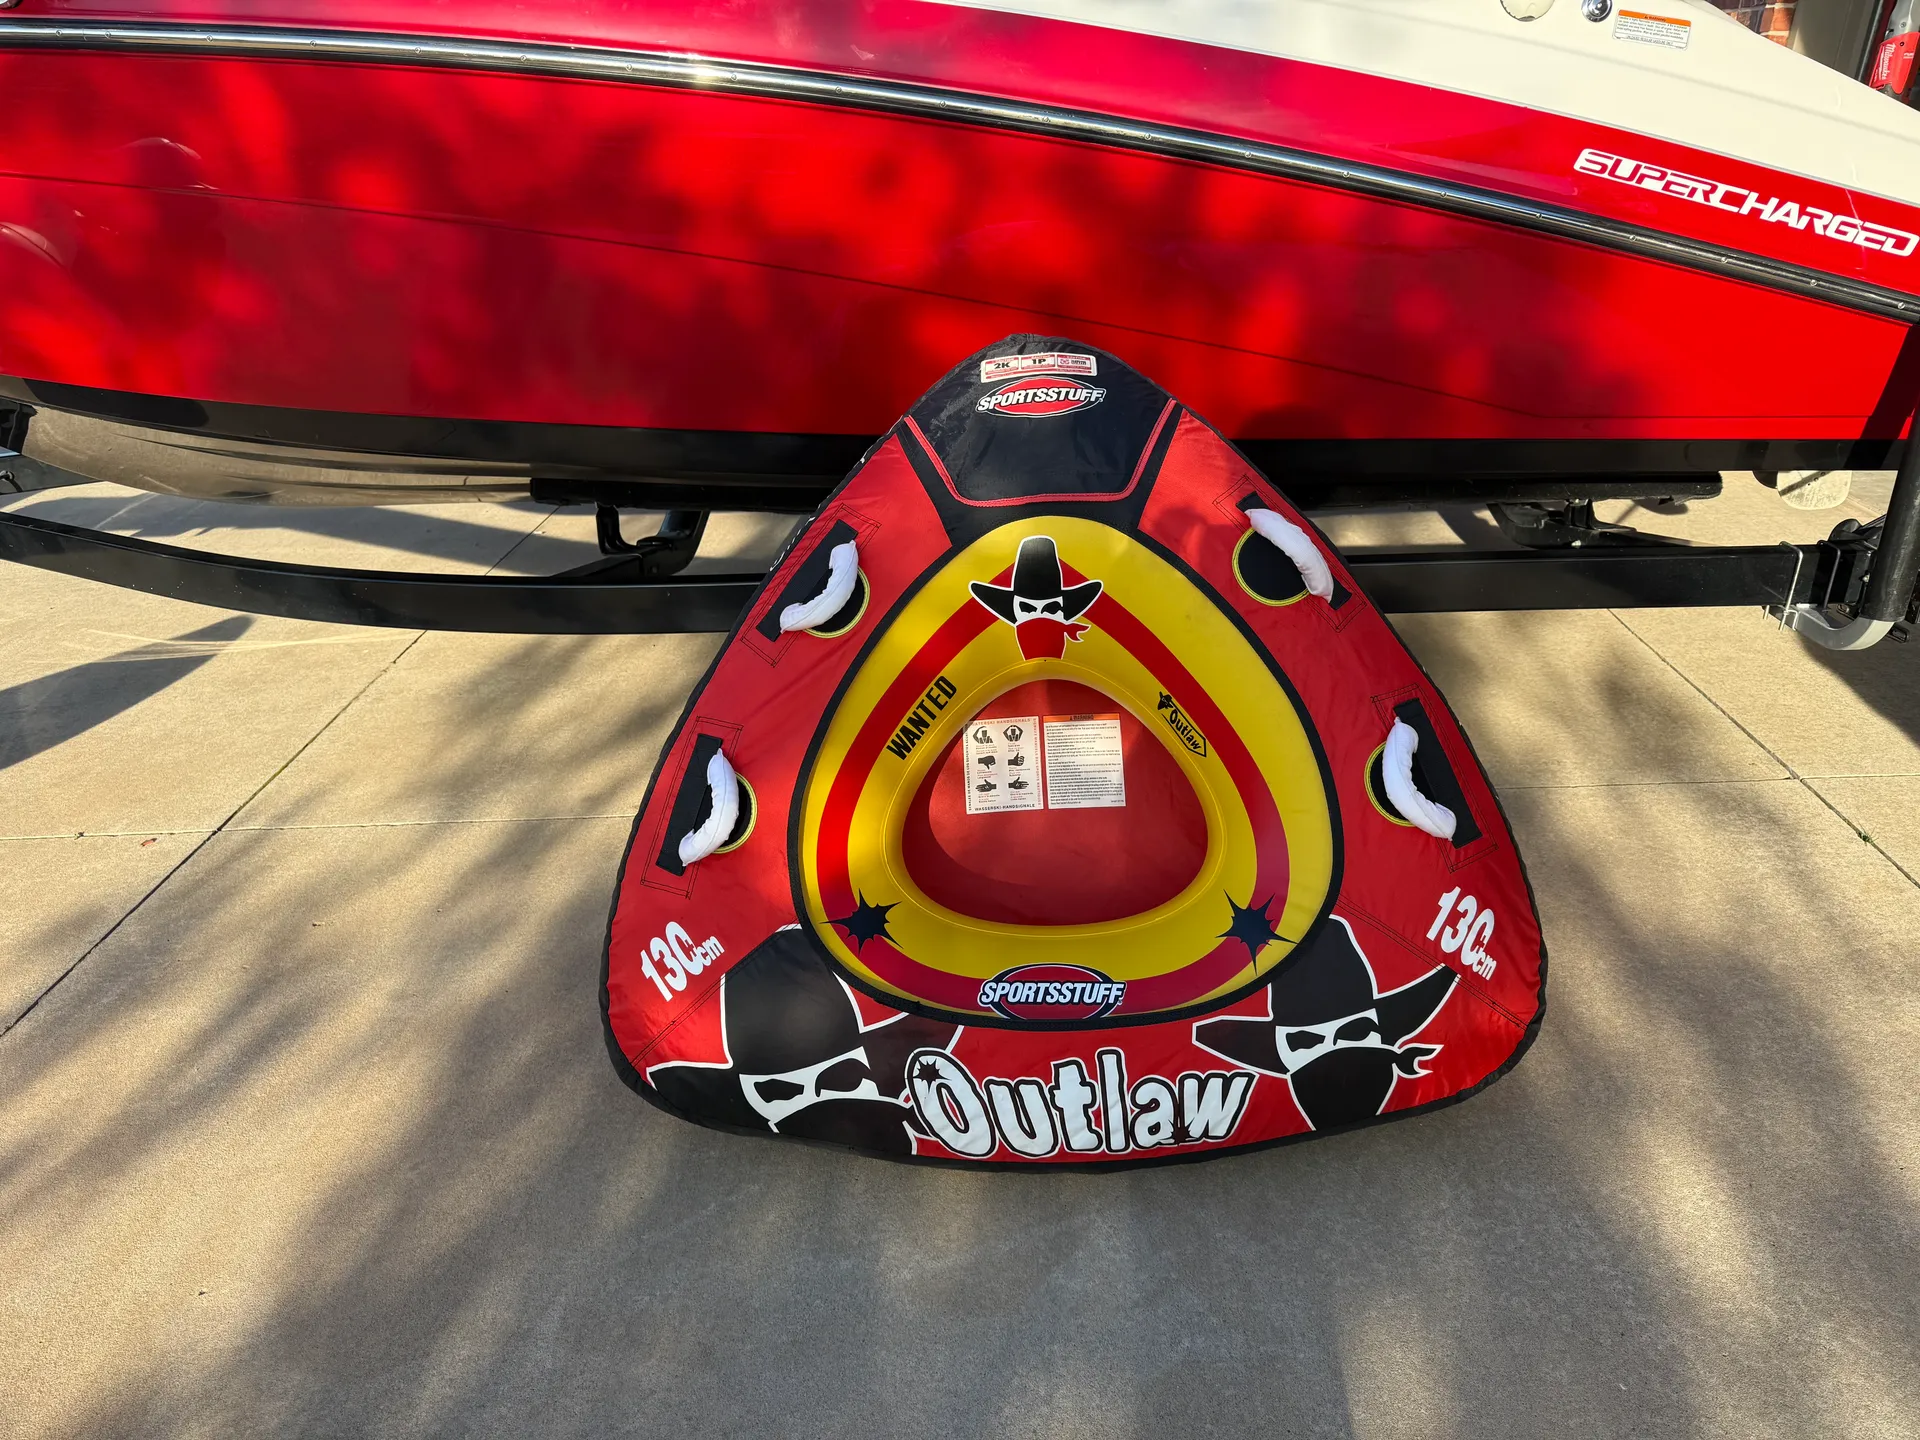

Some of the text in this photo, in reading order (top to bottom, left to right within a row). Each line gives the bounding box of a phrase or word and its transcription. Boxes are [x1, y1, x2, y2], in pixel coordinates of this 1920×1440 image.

[1882, 43, 1896, 80] Milwaukee
[1573, 148, 1919, 257] SUPERCHARGED
[978, 387, 1103, 411] SPORTSSTUFF
[886, 675, 957, 761] WANTED
[1169, 708, 1202, 750] Outlaw
[981, 981, 1124, 1004] SPORTSSTUFF
[905, 1047, 1259, 1160] Outlaw
